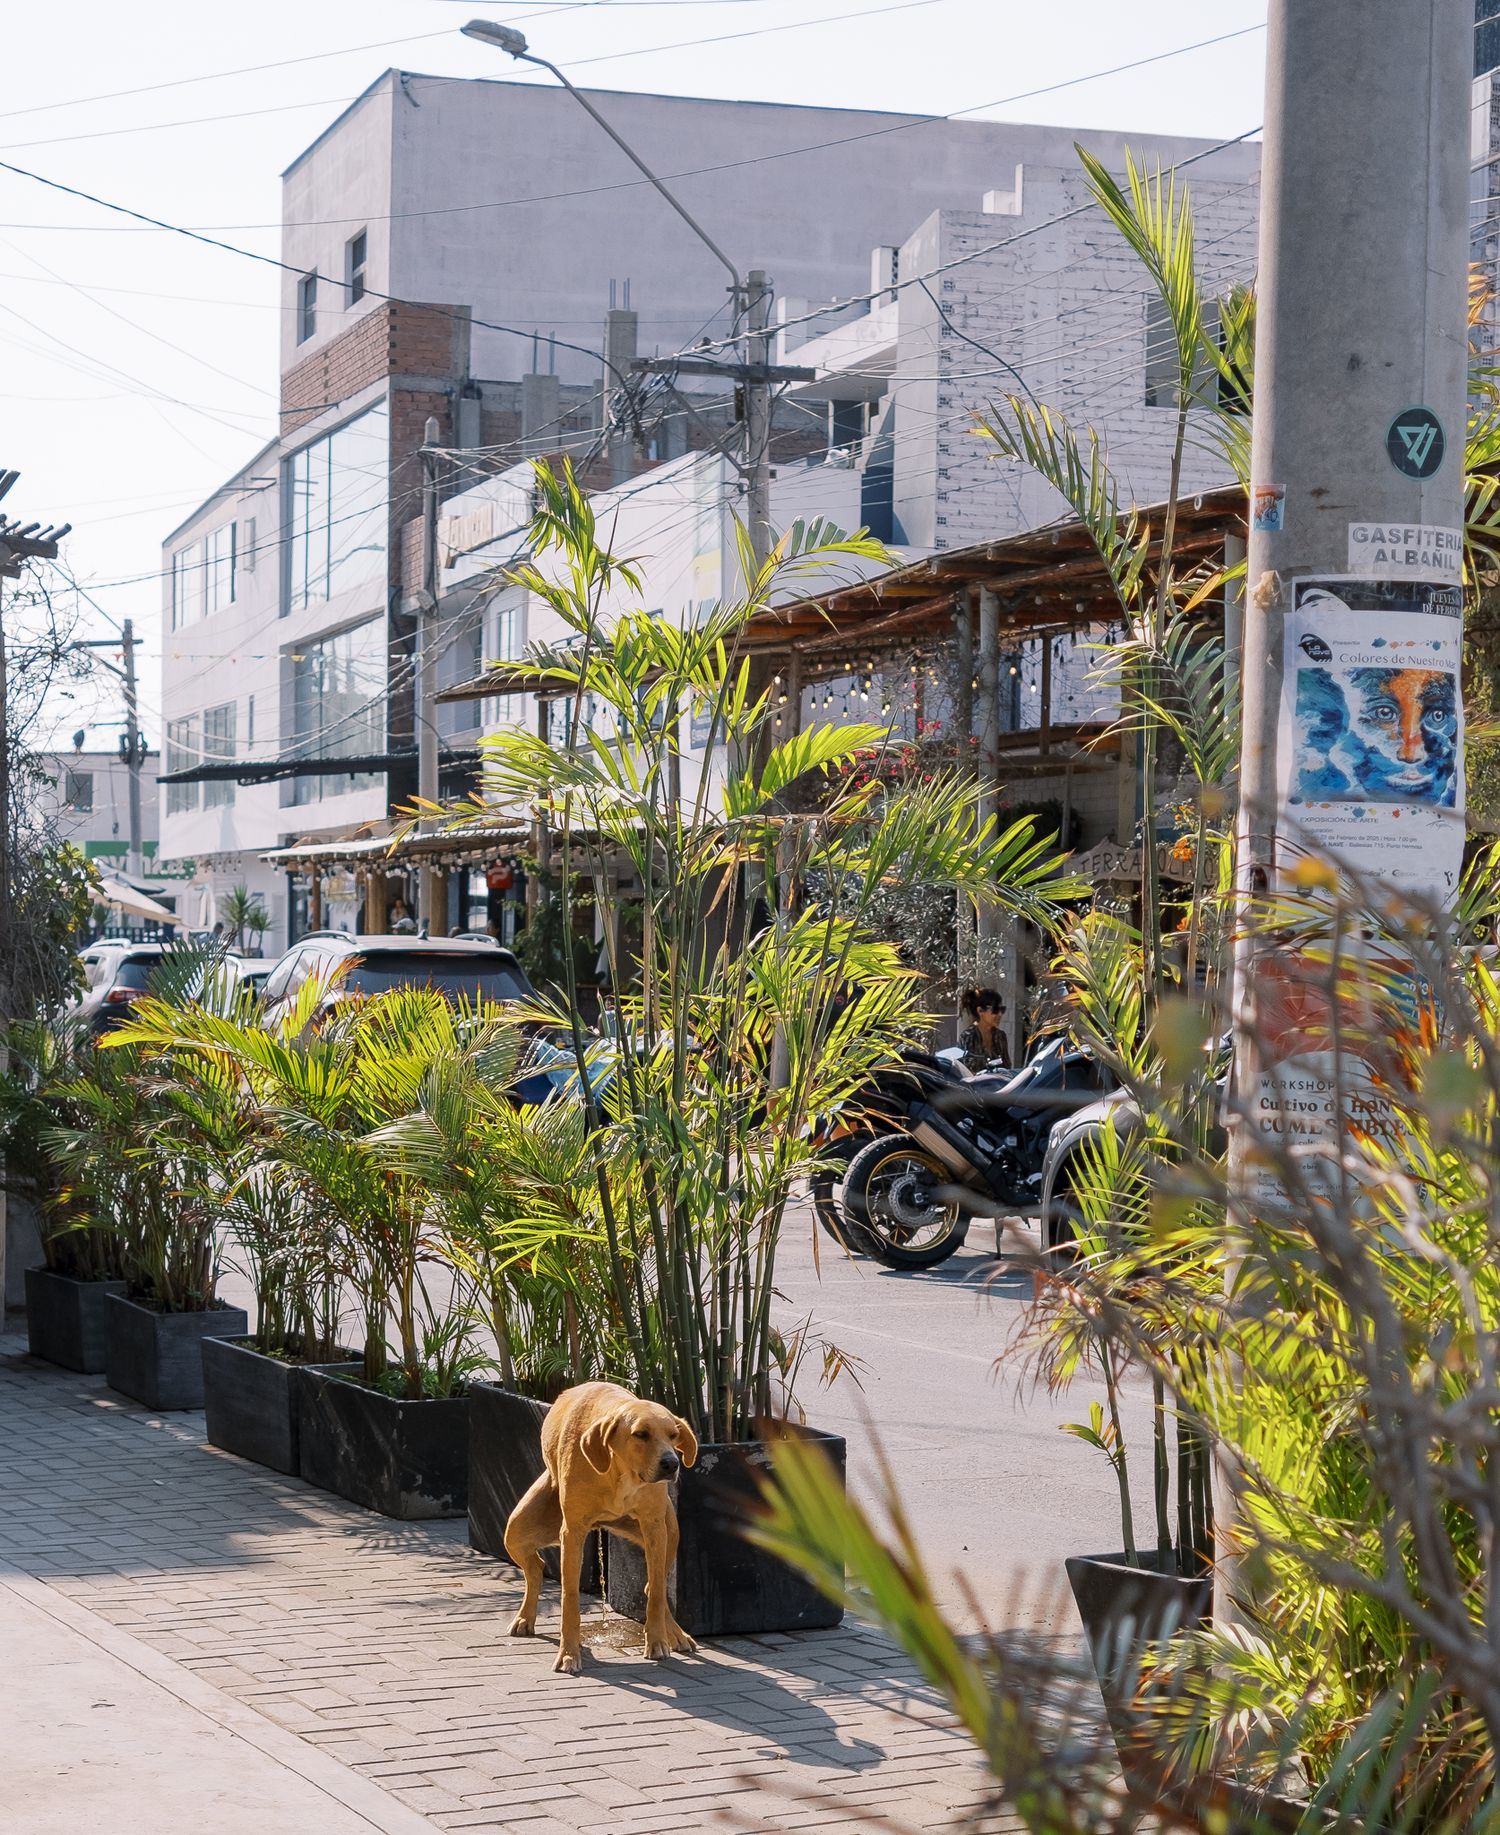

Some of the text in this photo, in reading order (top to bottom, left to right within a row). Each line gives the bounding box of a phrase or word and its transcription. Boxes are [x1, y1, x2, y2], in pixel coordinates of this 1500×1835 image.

[1352, 526, 1463, 552] GASFITERIA
[1373, 548, 1456, 571] ALBAÑIL
[1422, 603, 1434, 614] DE
[1339, 652, 1389, 665] Colores
[1391, 653, 1405, 665] de
[1408, 655, 1445, 668] Nuestro
[1300, 815, 1346, 823] EXPOSICIÓN
[1348, 816, 1358, 824] DE
[1079, 851, 1142, 877] TERRA
[1261, 1080, 1335, 1091] WORKSHOP
[1260, 1097, 1318, 1112] Cutivo
